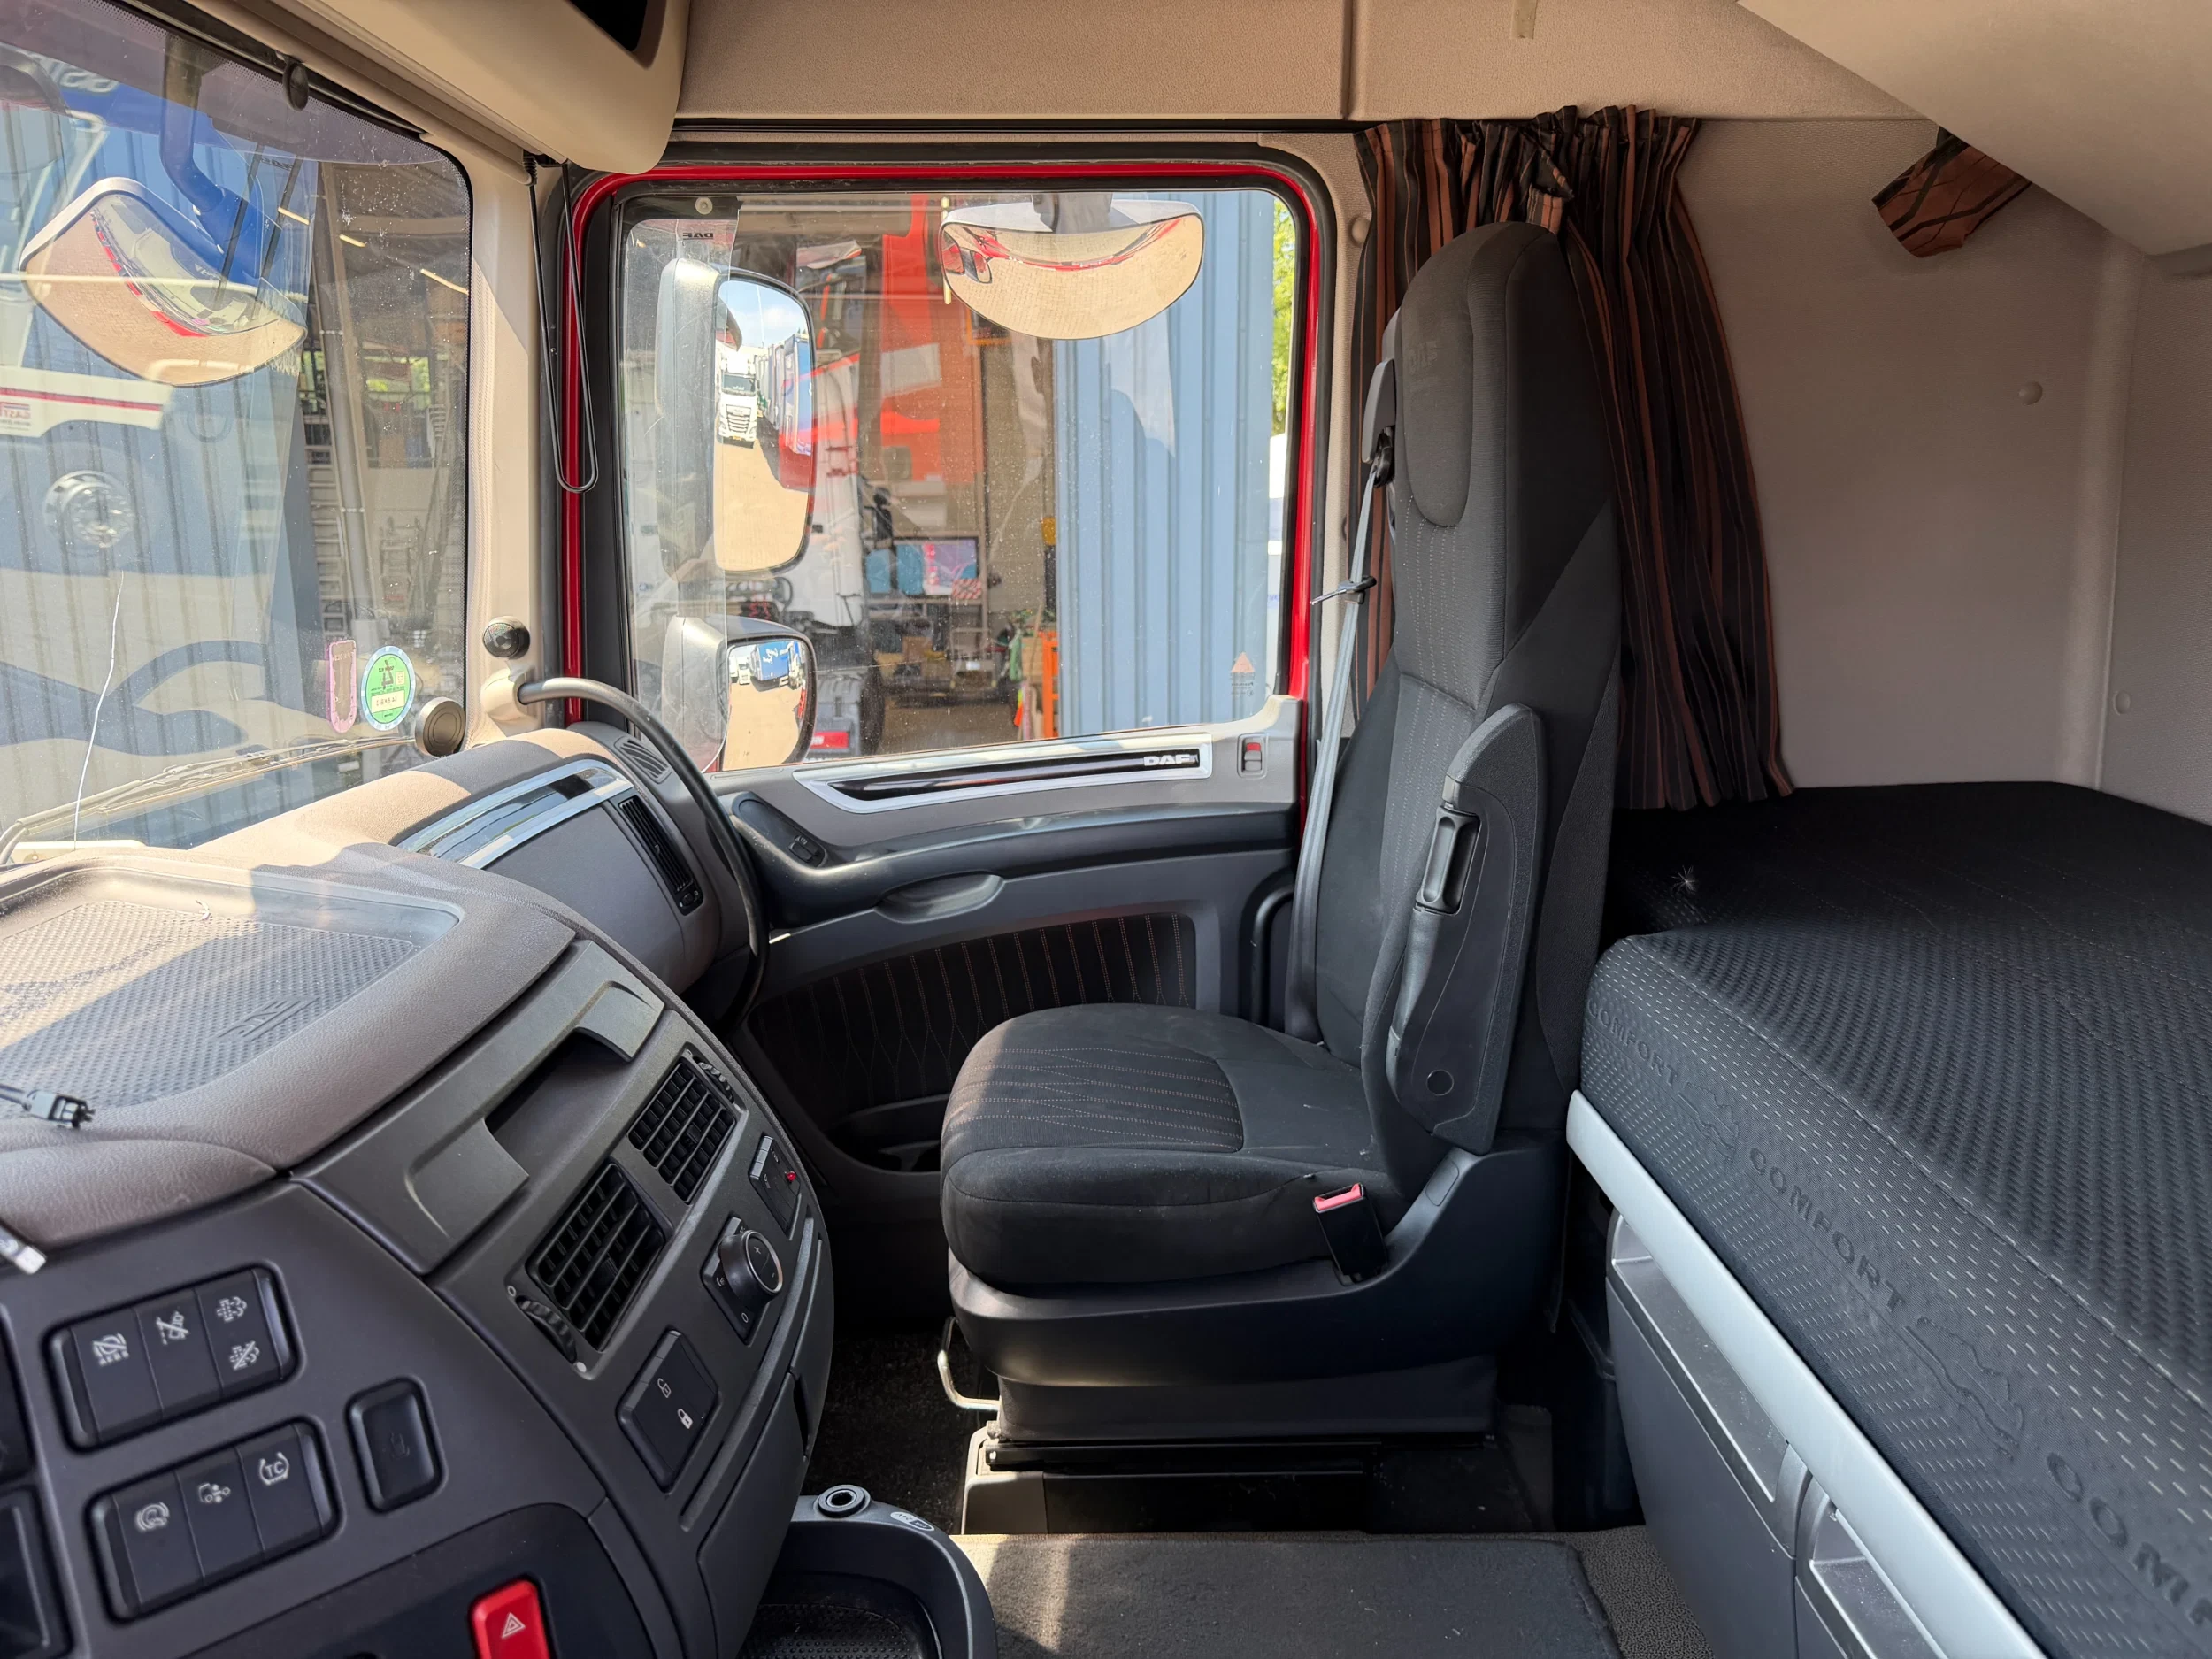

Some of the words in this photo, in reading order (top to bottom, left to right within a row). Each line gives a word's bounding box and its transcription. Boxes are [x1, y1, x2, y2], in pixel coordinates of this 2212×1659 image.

[1143, 754, 1190, 766] DAF
[1587, 998, 1678, 1087] COMFORT
[1749, 1147, 1906, 1313] COMFORT
[265, 1461, 284, 1477] TC
